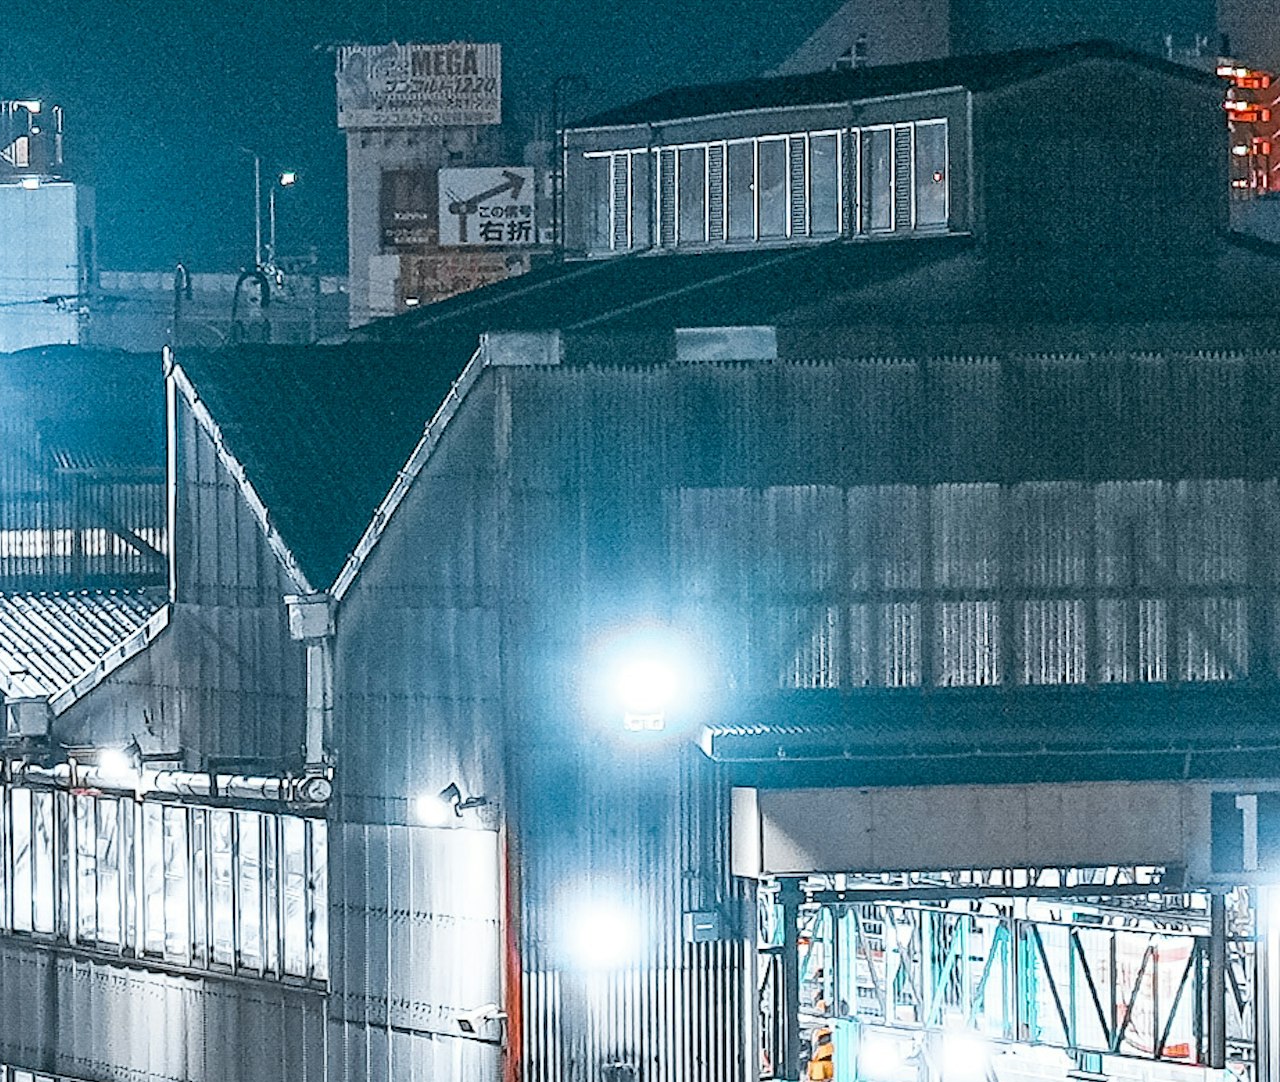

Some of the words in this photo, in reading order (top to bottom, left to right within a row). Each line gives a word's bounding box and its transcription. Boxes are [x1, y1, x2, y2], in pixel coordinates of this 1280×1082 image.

[411, 50, 478, 76] MEGA
[479, 205, 532, 218] この信号
[479, 220, 532, 241] 右折
[1235, 794, 1258, 870] 1
